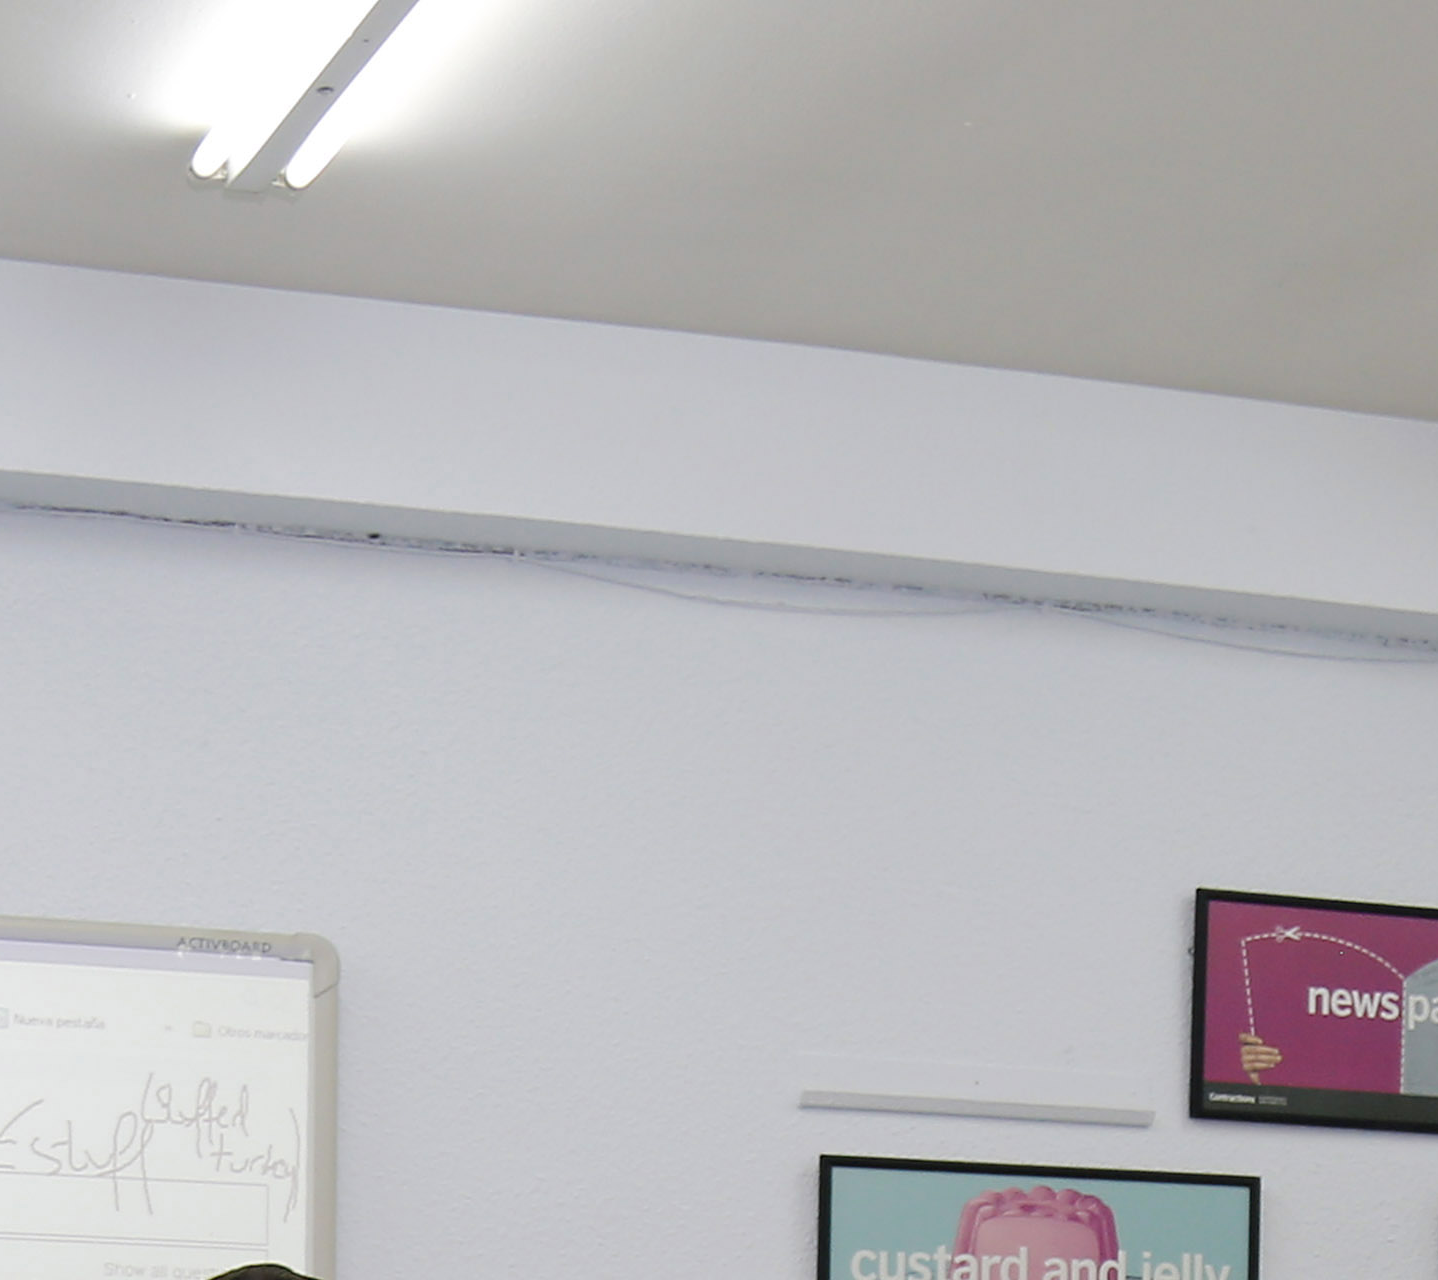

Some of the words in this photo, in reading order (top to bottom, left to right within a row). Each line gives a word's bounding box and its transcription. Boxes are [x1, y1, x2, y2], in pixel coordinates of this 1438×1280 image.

[177, 936, 273, 953] ACTIVBOARD
[1308, 986, 1400, 1020] news
[14, 1012, 53, 1026] Nueva
[104, 1262, 146, 1276] Show
[151, 1265, 168, 1277] all
